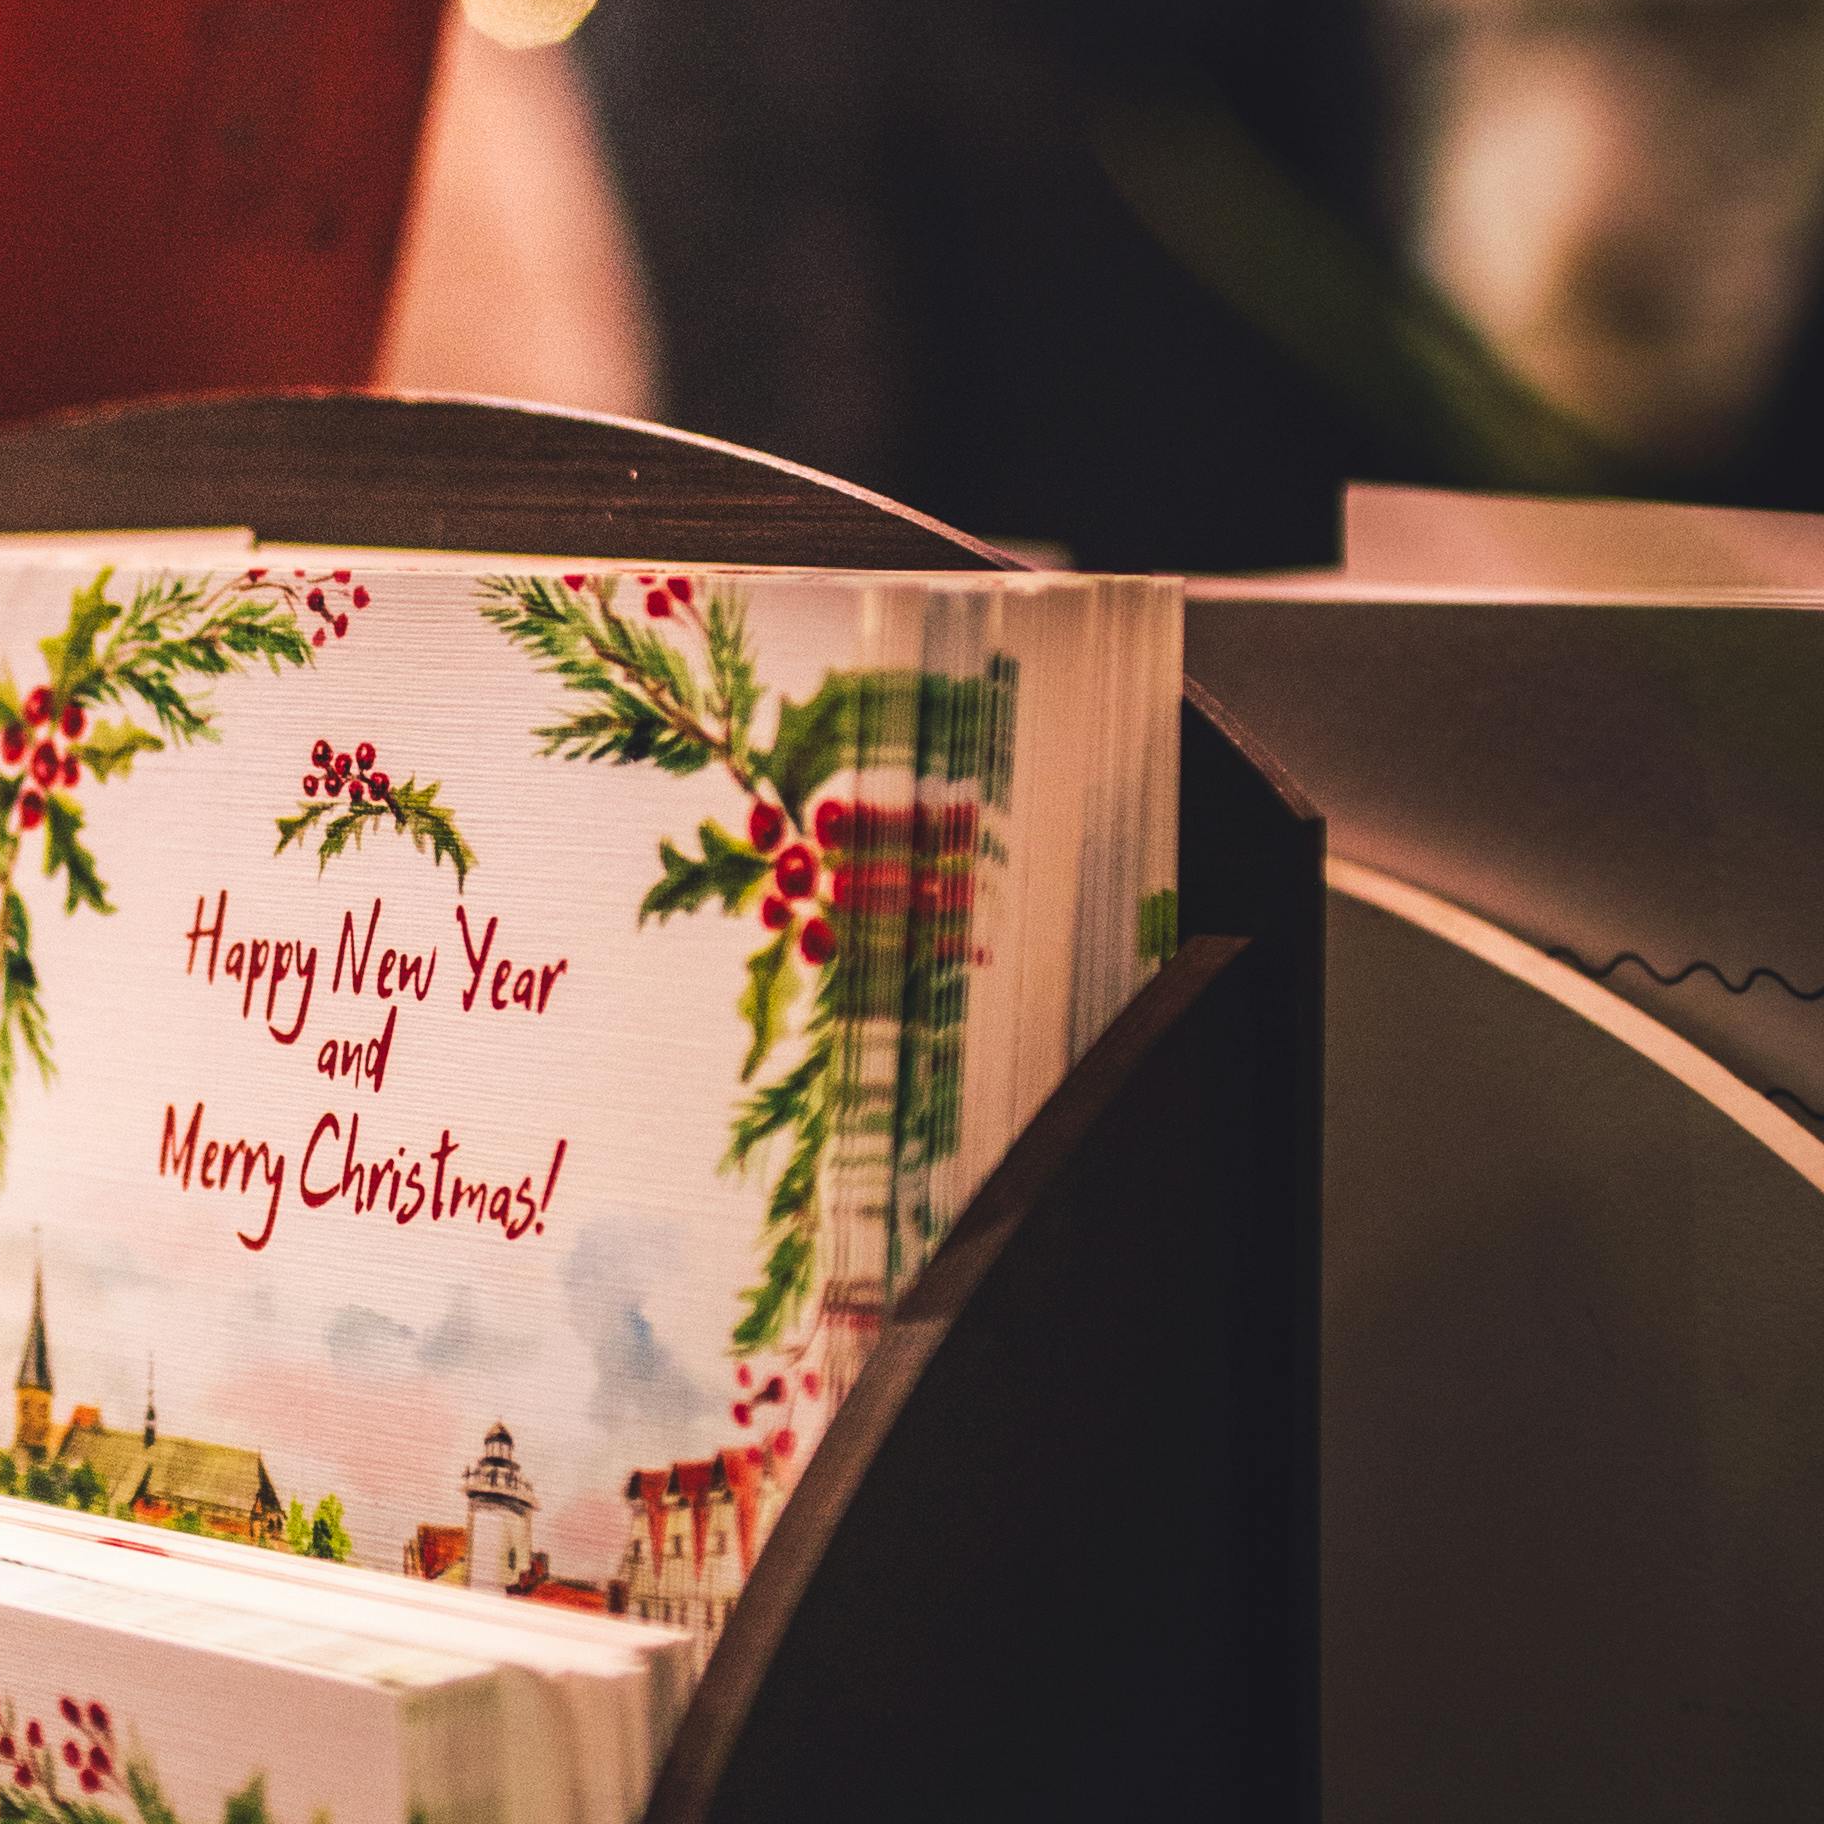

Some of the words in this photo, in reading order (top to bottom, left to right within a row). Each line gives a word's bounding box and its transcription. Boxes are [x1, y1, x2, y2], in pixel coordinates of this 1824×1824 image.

[185, 888, 317, 1045] Happy
[332, 897, 438, 1001] New
[456, 904, 569, 1014] Year
[316, 1004, 398, 1093] and
[158, 1101, 285, 1251] Merry
[299, 1111, 568, 1241] Christmas!
